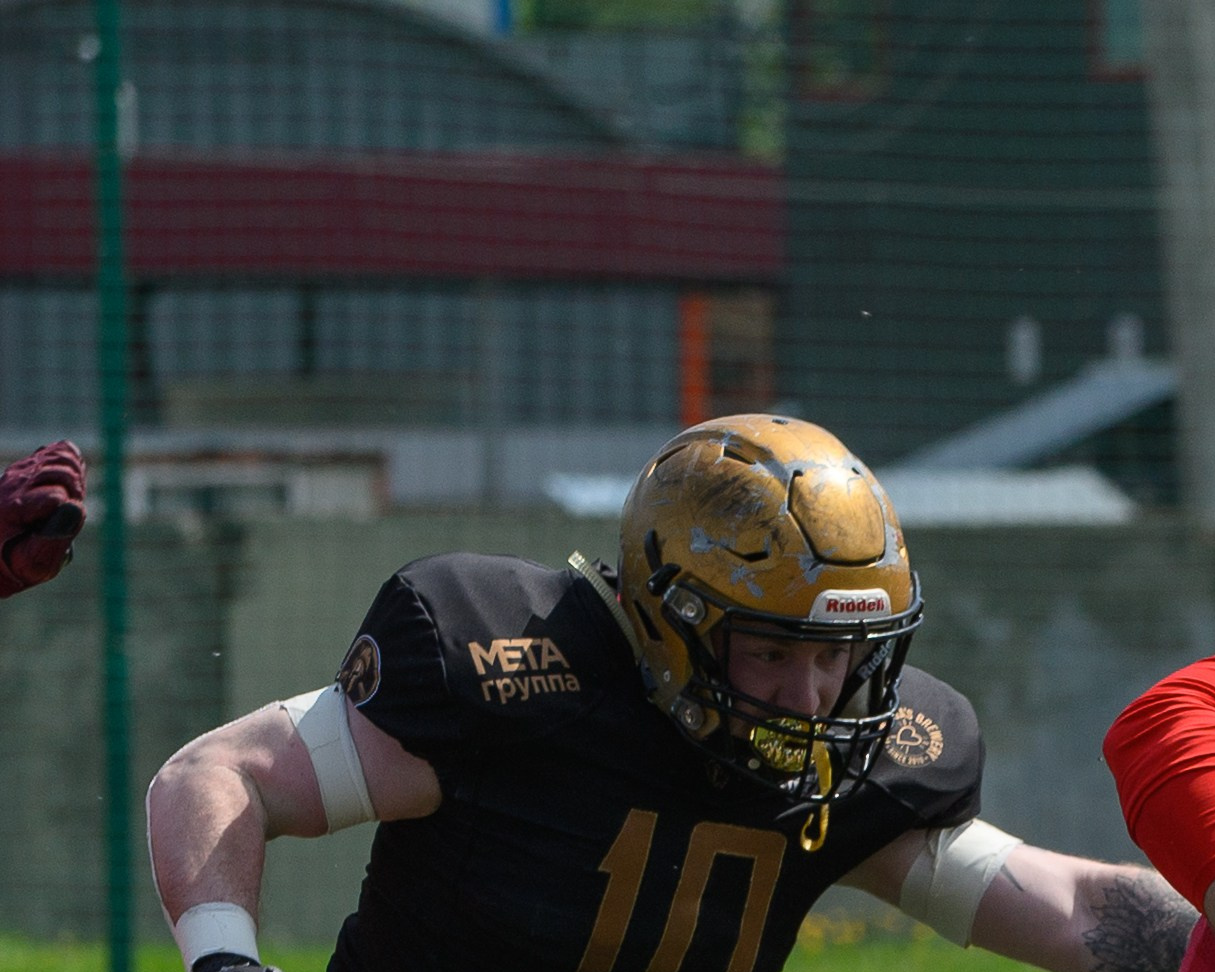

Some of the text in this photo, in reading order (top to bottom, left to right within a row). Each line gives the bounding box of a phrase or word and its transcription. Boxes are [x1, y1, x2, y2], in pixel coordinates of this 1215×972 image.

[825, 597, 885, 613] Riddell
[480, 673, 581, 705] группа
[915, 712, 944, 762] BREWERY
